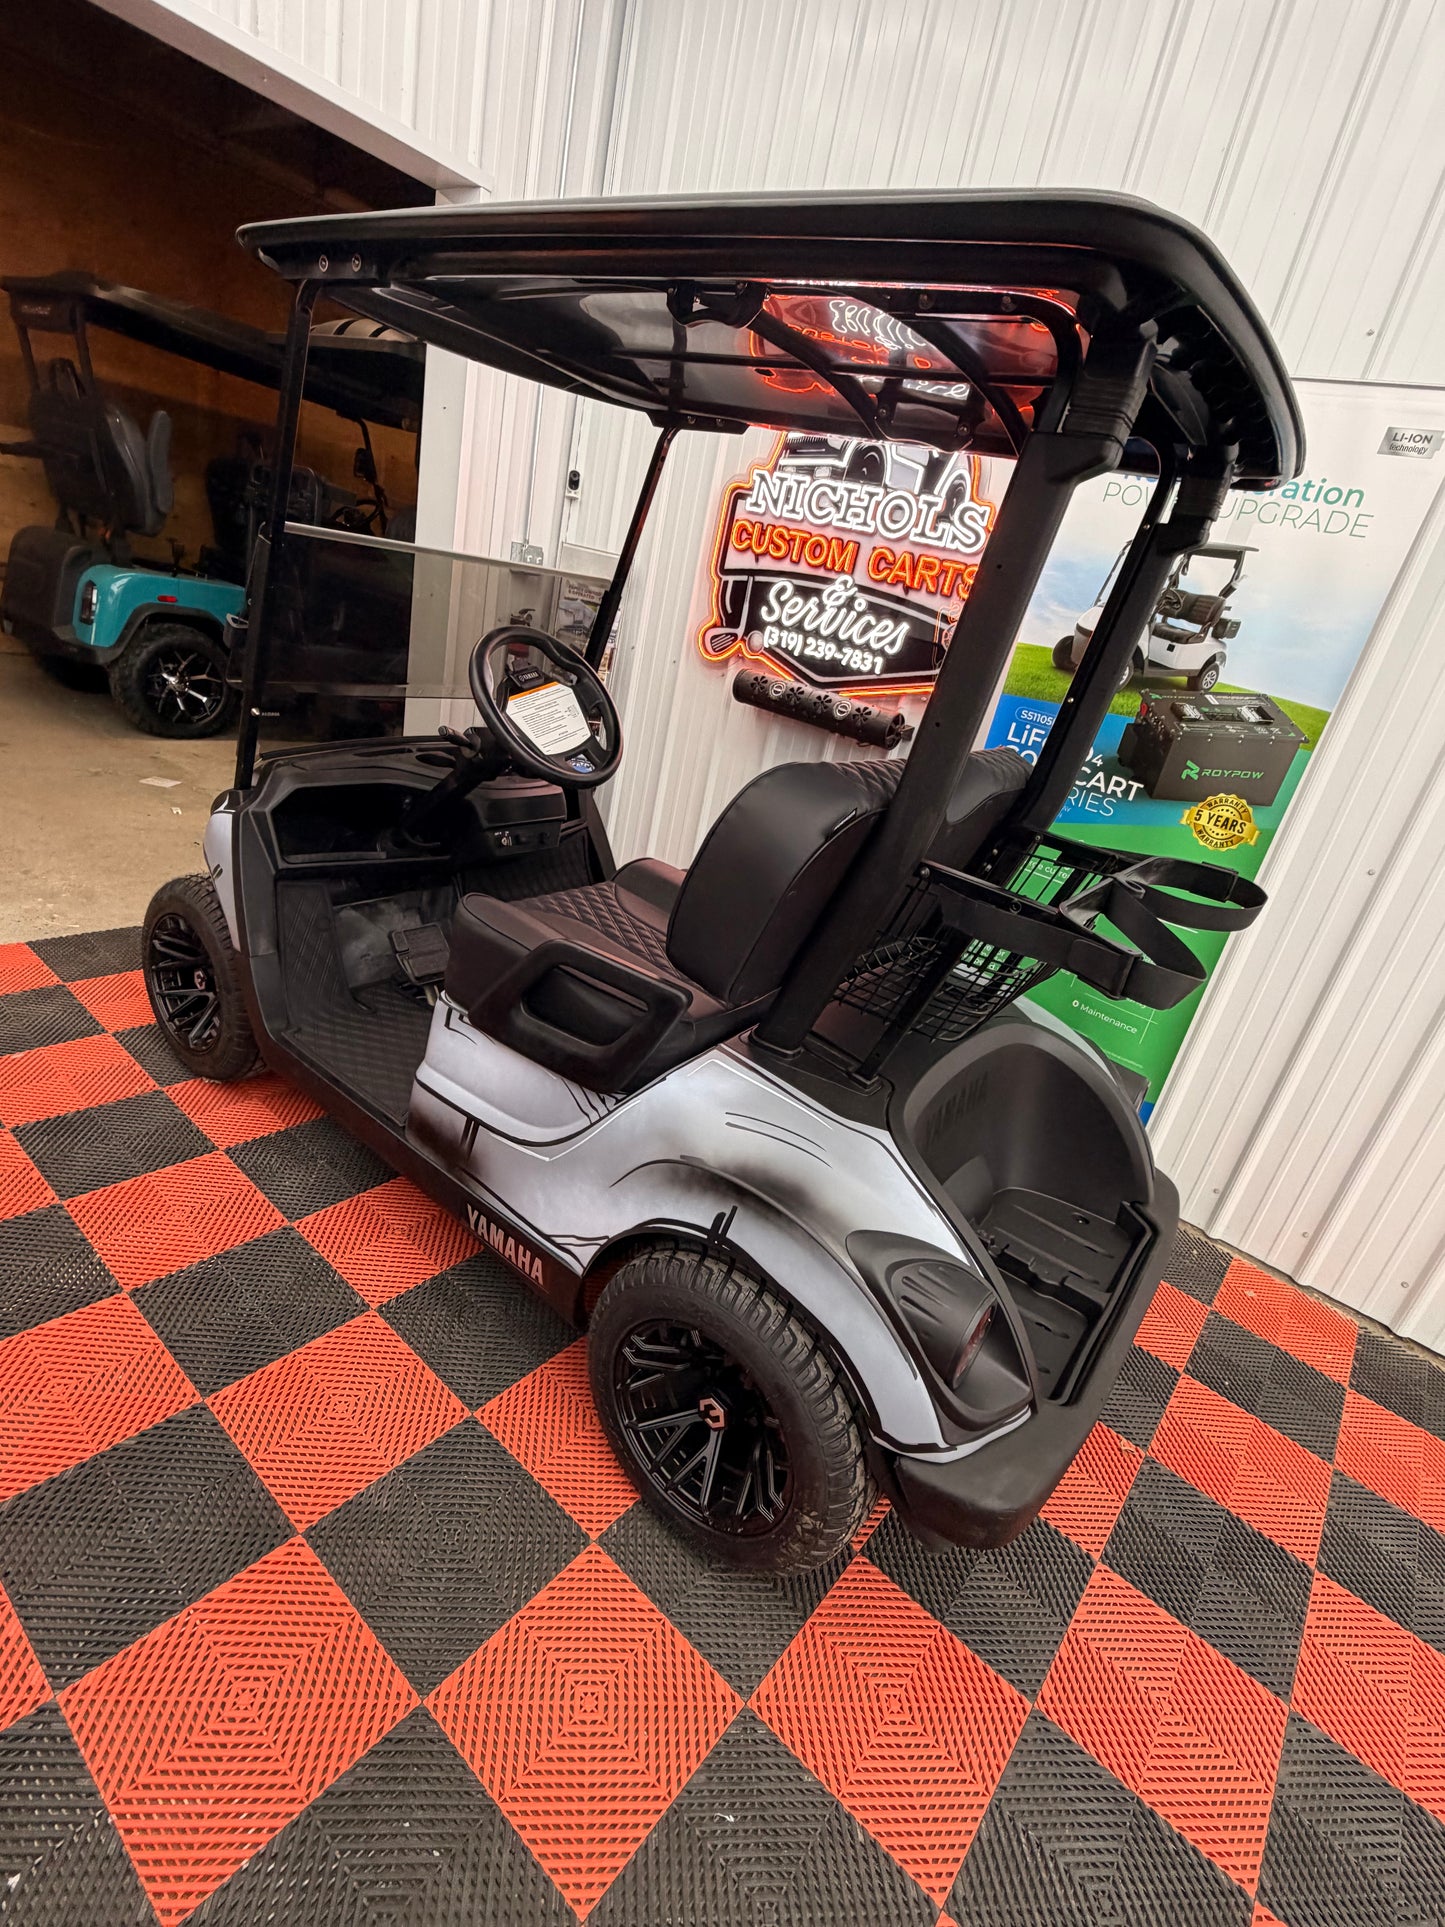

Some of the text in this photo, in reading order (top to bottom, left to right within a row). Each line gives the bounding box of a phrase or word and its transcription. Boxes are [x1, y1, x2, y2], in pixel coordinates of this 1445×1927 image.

[1389, 443, 1429, 455] technology
[1392, 432, 1434, 444] LI-ION
[746, 469, 990, 554] NICHOLS
[731, 519, 978, 601] CUSTOM CARTS
[822, 575, 857, 607] &
[761, 581, 911, 655] Services
[763, 625, 884, 675] (319) 239-7831
[1020, 709, 1056, 728] S51105
[1201, 768, 1265, 779] ROYPOW
[1206, 797, 1249, 814] WARRANTY
[1194, 809, 1247, 834] 5 YEARS
[1080, 1003, 1138, 1034] Maintenance
[466, 1203, 545, 1286] YAMAHA
